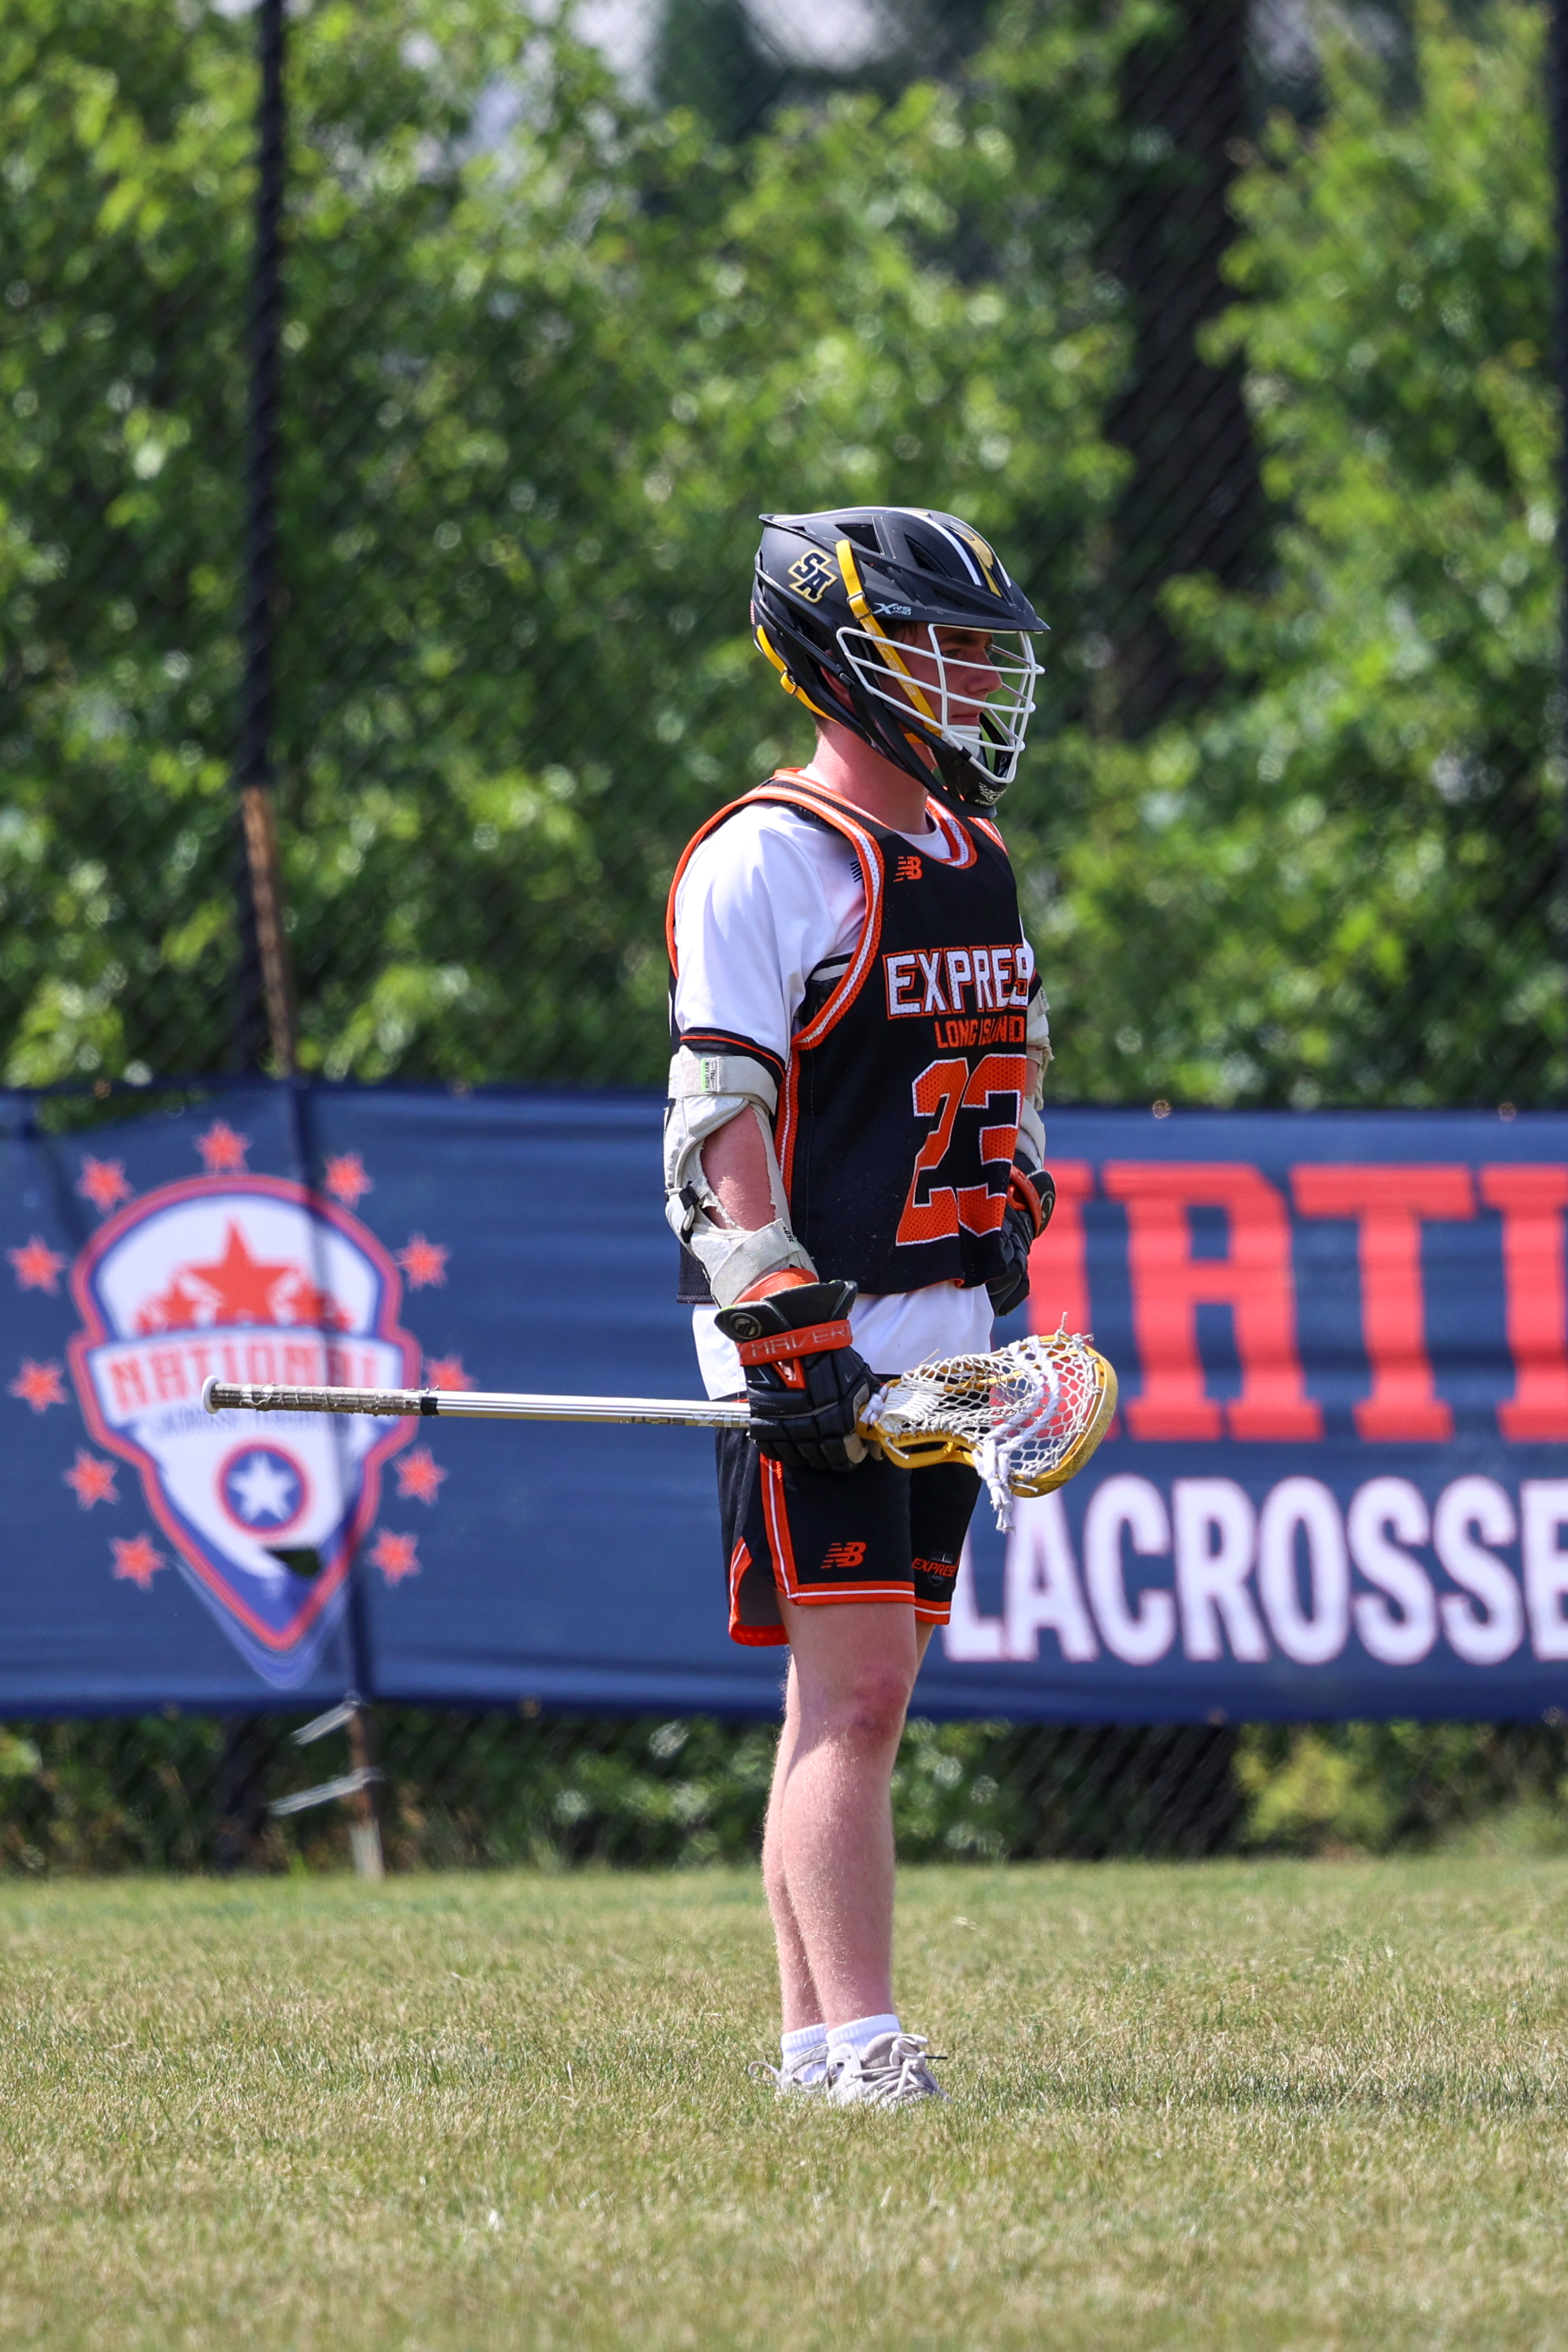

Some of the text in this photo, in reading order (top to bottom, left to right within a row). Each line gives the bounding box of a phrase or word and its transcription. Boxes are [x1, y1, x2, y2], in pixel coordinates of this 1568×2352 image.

[934, 1019, 978, 1048] LONG
[896, 1053, 1027, 1246] 23
[942, 1474, 1568, 1666] LACROSSE
